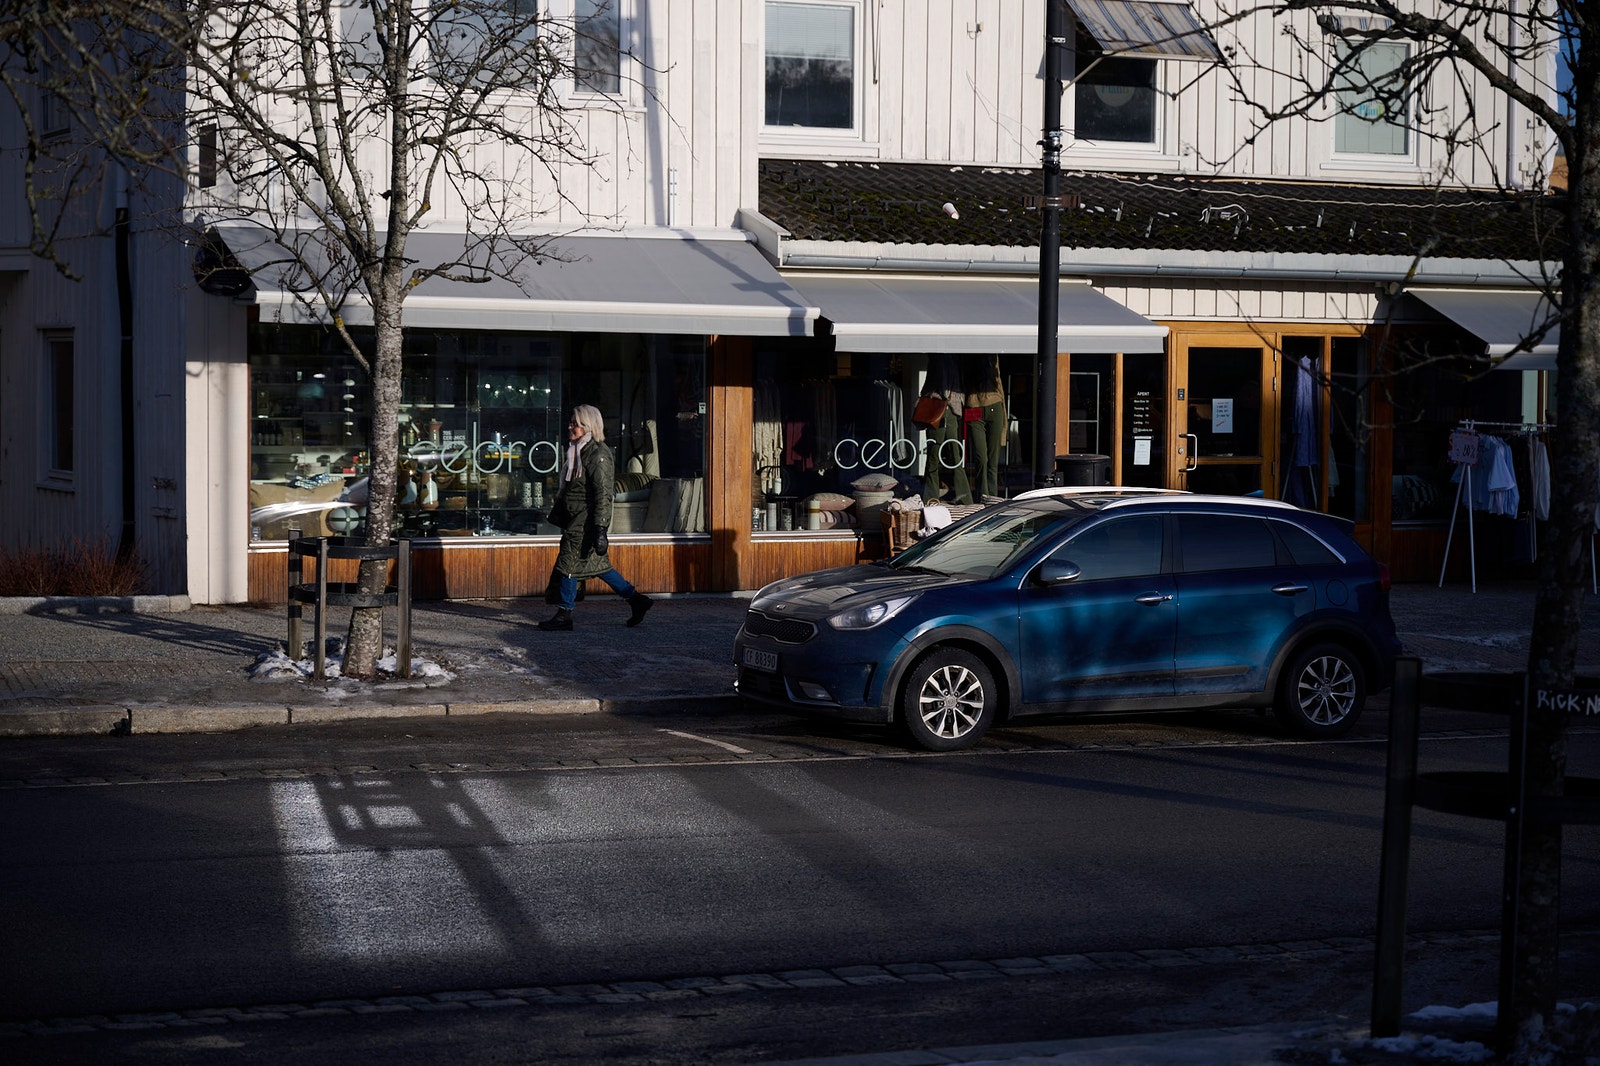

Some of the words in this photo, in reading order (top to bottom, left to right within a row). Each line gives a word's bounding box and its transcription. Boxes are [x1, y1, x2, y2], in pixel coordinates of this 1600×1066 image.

[409, 421, 559, 474] cebra
[834, 420, 966, 469] cebra
[755, 651, 776, 669] 88390
